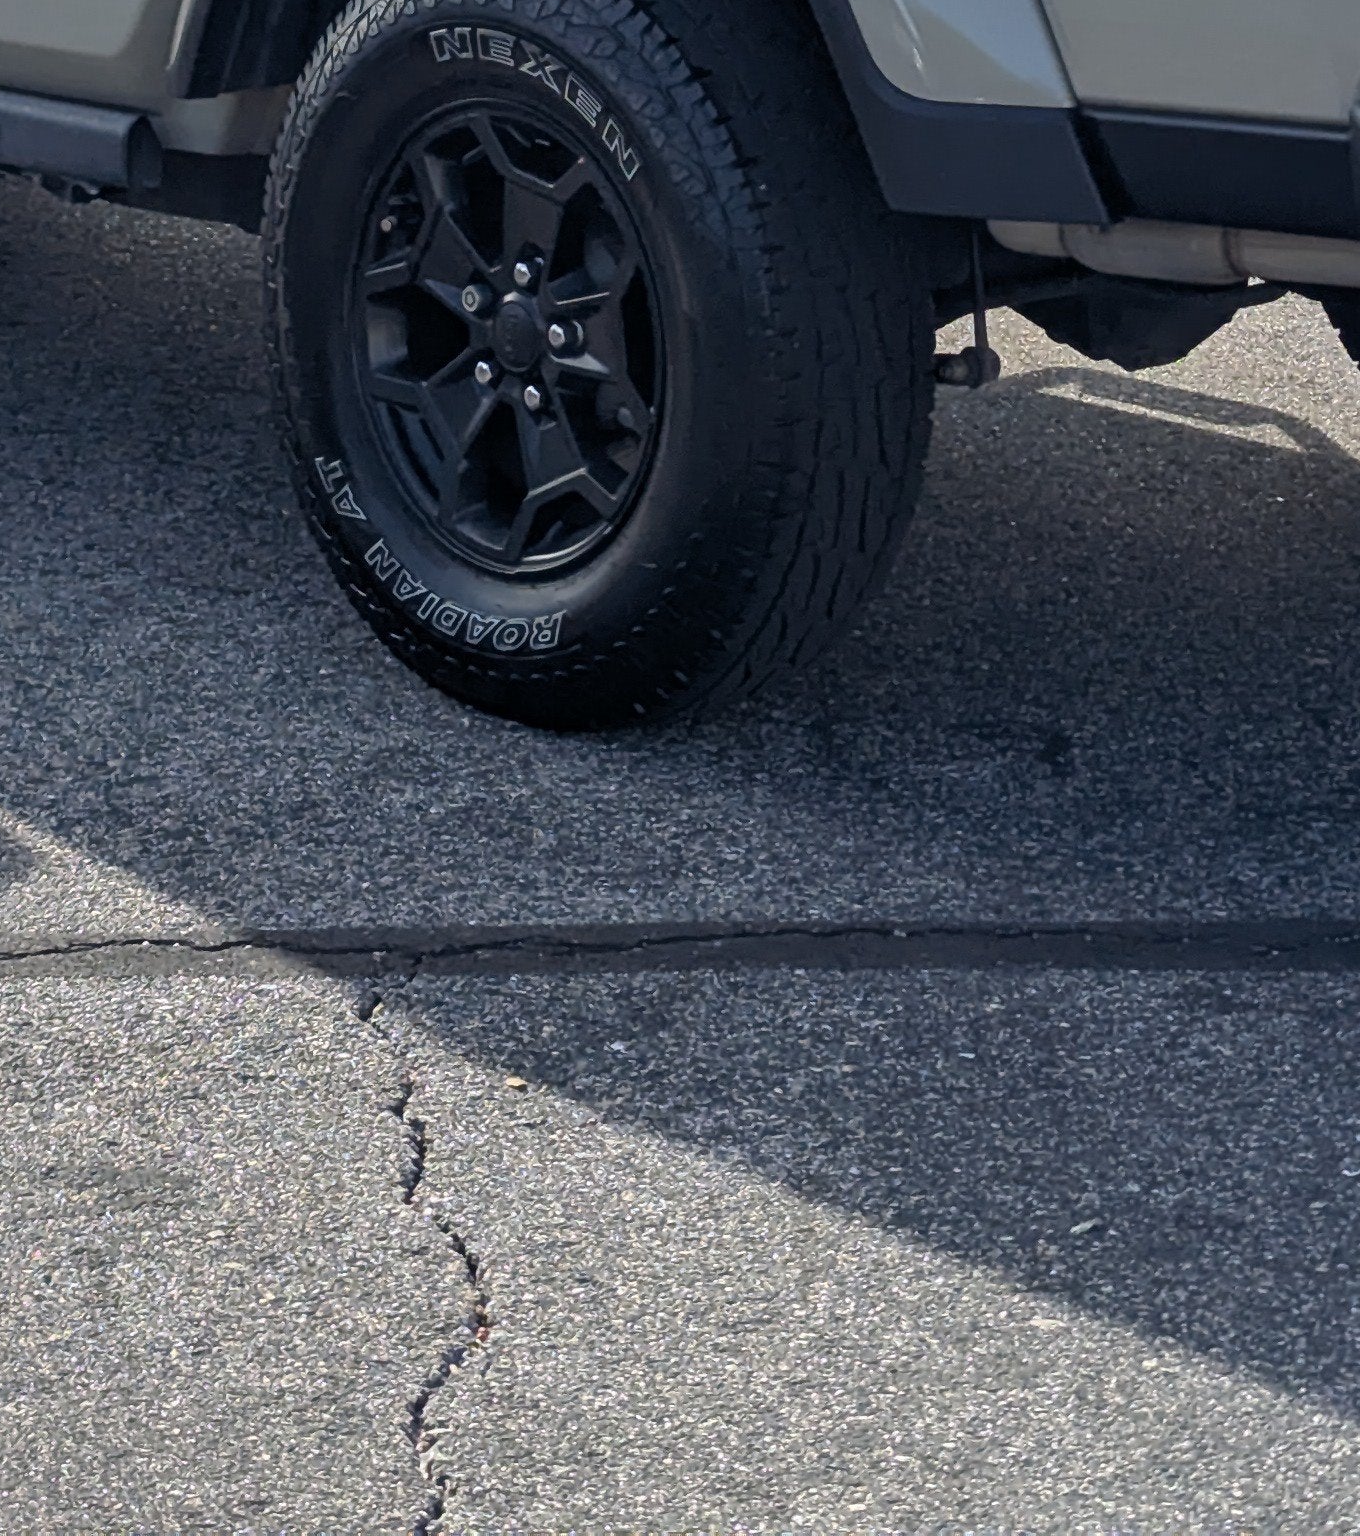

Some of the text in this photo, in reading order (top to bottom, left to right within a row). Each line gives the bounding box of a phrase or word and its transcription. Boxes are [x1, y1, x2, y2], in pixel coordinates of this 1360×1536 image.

[429, 27, 640, 181] NEXEN
[314, 456, 567, 651] ROADIAN AT
